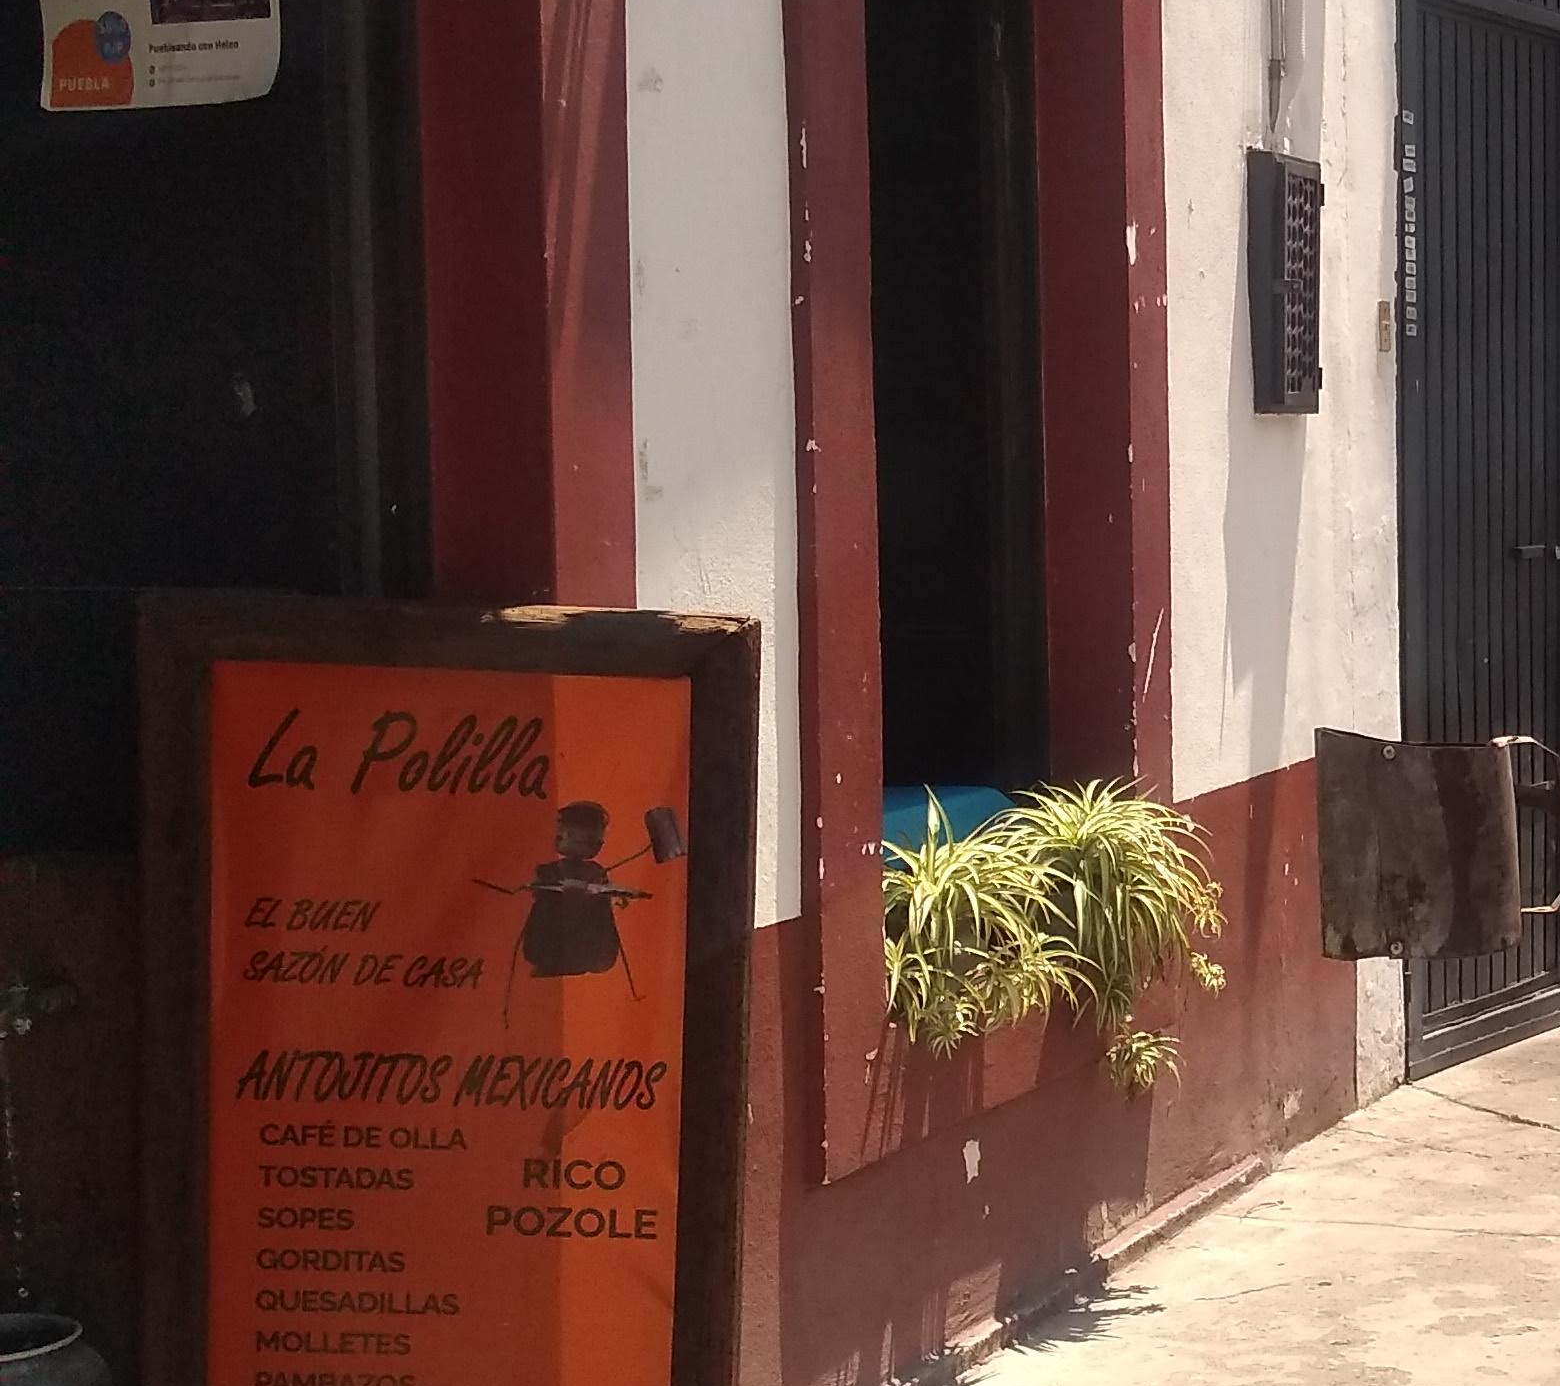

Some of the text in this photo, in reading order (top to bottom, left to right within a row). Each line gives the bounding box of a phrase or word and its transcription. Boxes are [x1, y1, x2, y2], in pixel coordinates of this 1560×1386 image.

[58, 76, 111, 92] PUEBLA
[247, 708, 552, 800] La Polilla
[245, 897, 383, 934] EL BUEN
[243, 944, 484, 991] SAZÓN DE CASA
[235, 1049, 668, 1111] ANTOJITOS MEXICANOS
[259, 1119, 468, 1151] CAFÉ DE OLLA
[259, 1164, 415, 1190] TOSTADAS
[522, 1158, 626, 1191] RICO
[257, 1207, 355, 1231] SOPES
[485, 1204, 659, 1241] POZOLE
[256, 1248, 406, 1273] GORDITAS
[255, 1289, 460, 1316] QUESADILLAS
[255, 1331, 412, 1356] MOLLETES
